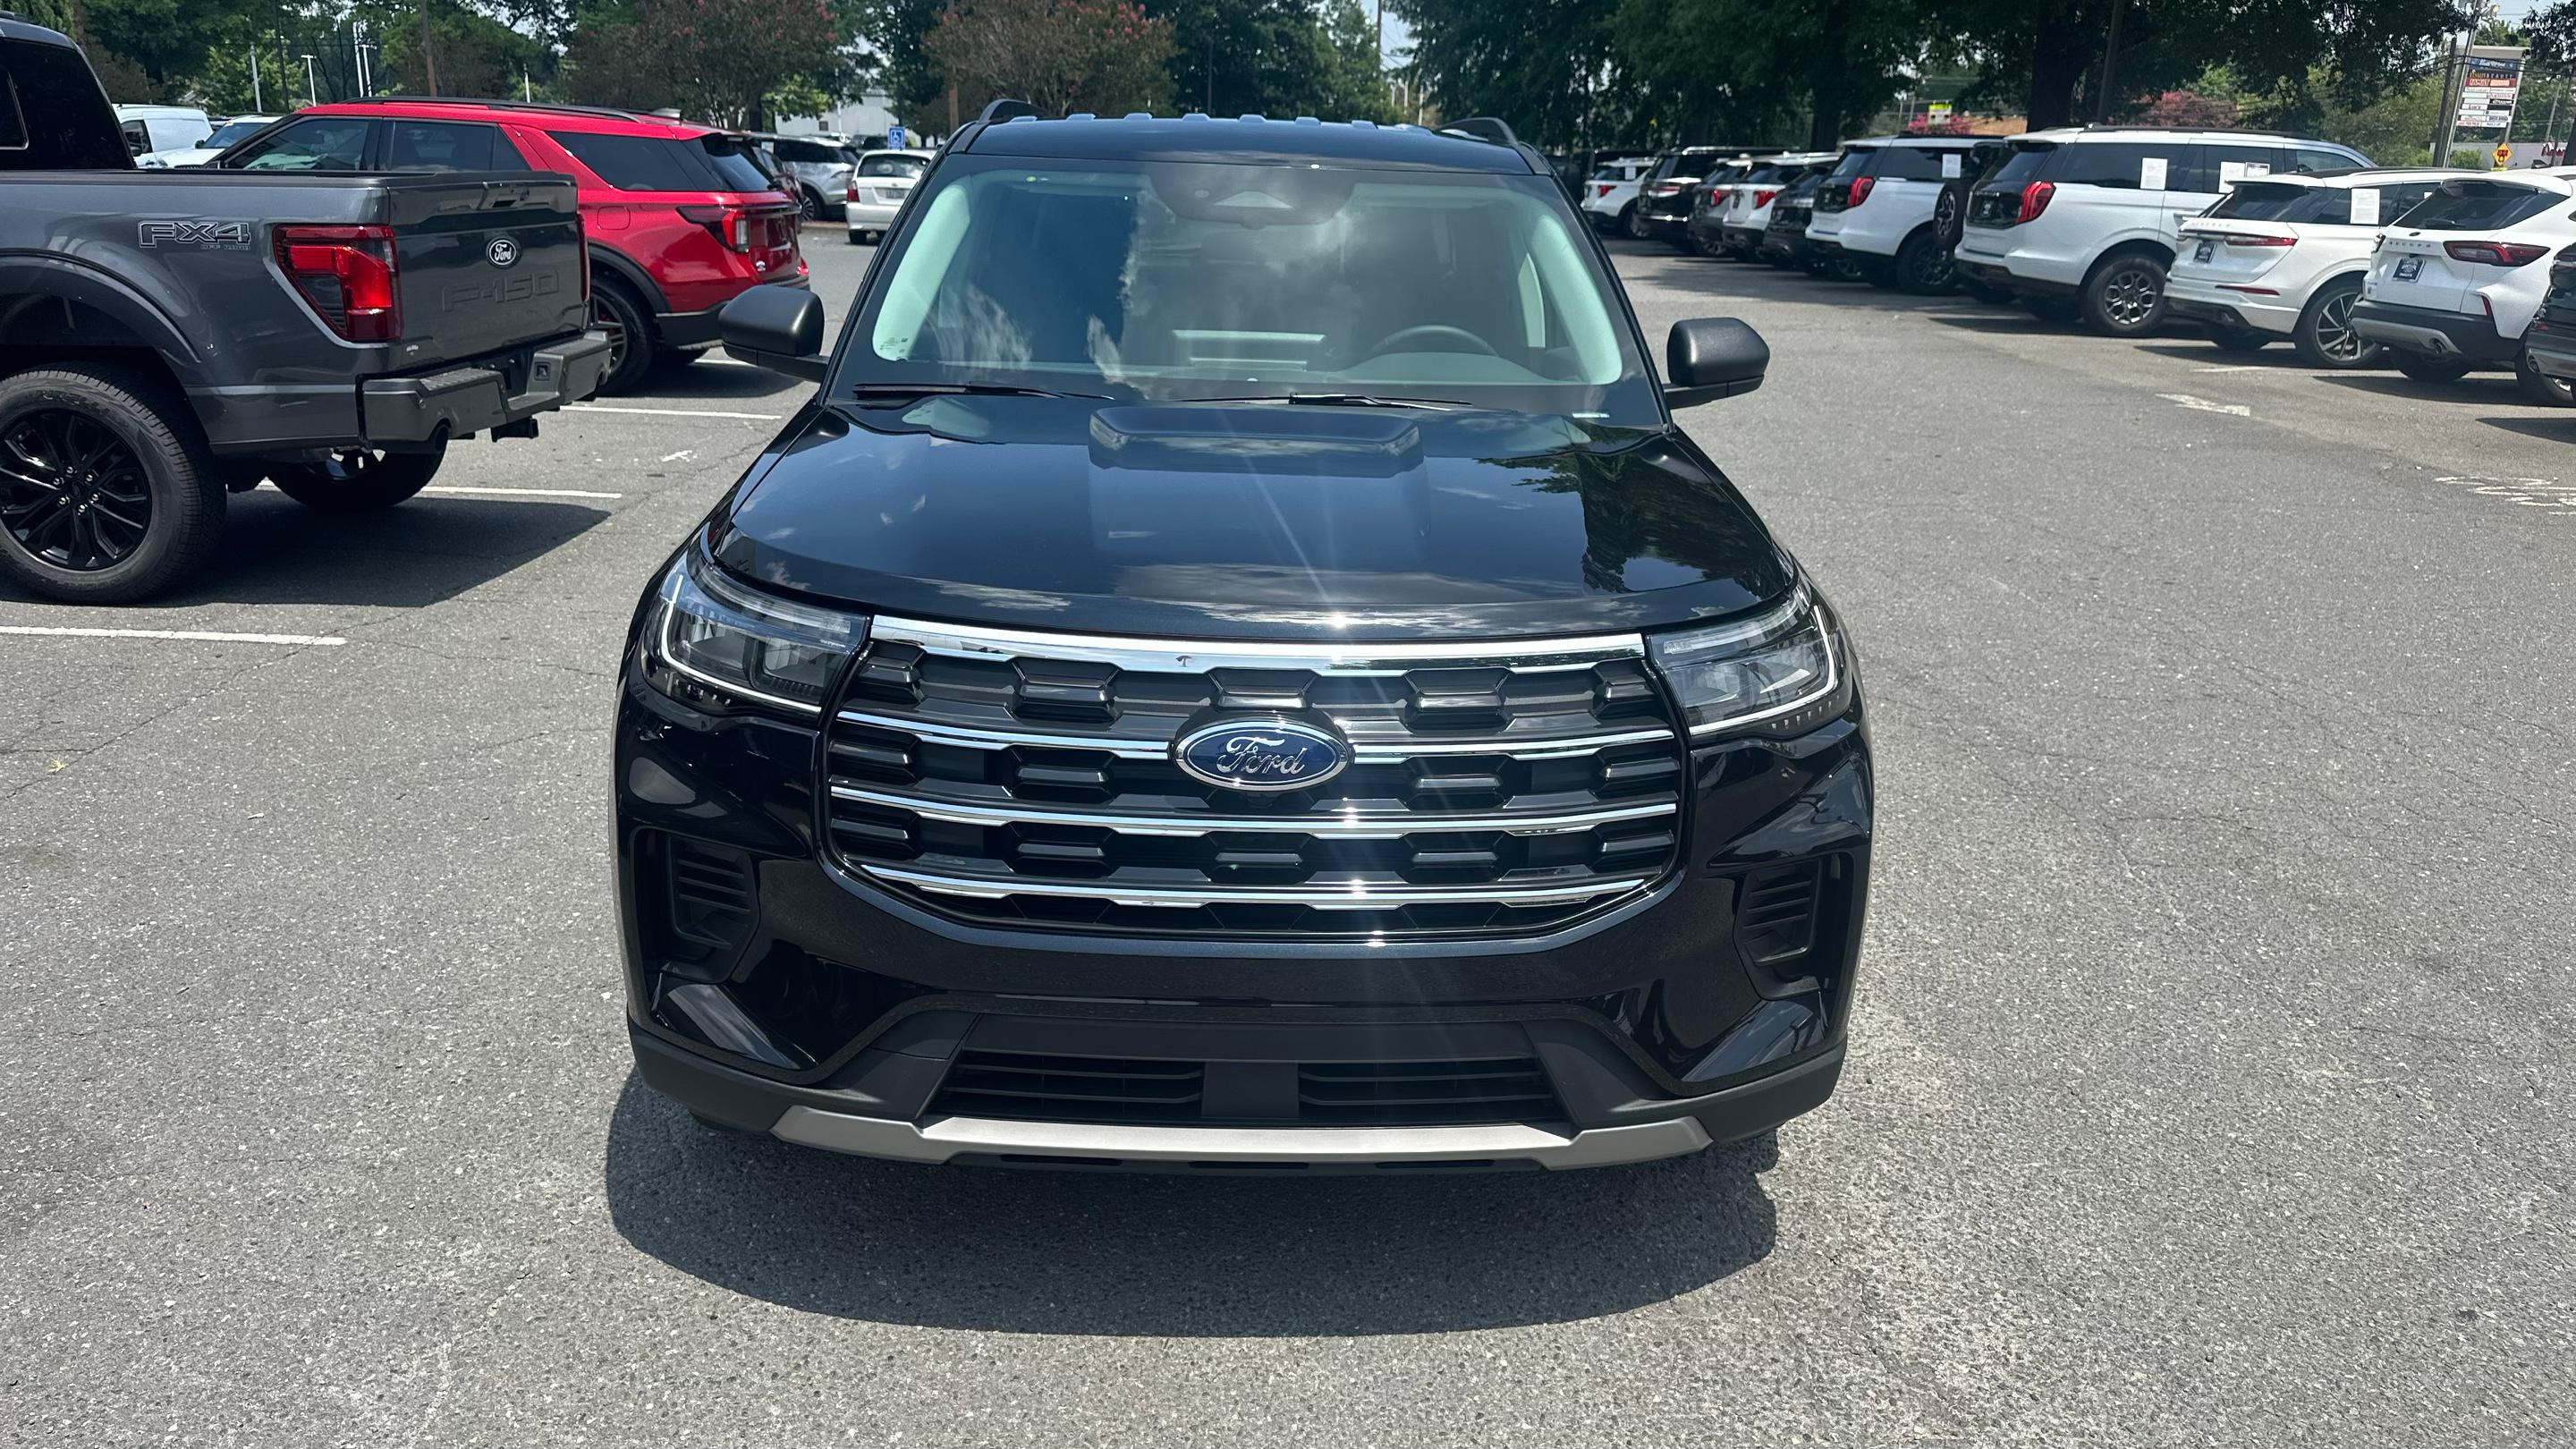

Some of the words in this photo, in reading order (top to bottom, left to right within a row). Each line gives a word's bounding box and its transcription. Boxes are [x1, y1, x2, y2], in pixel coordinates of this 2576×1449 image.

[137, 220, 251, 248] FX4
[494, 242, 513, 261] Ford
[442, 271, 560, 313] F-150
[1216, 735, 1308, 775] Ford
